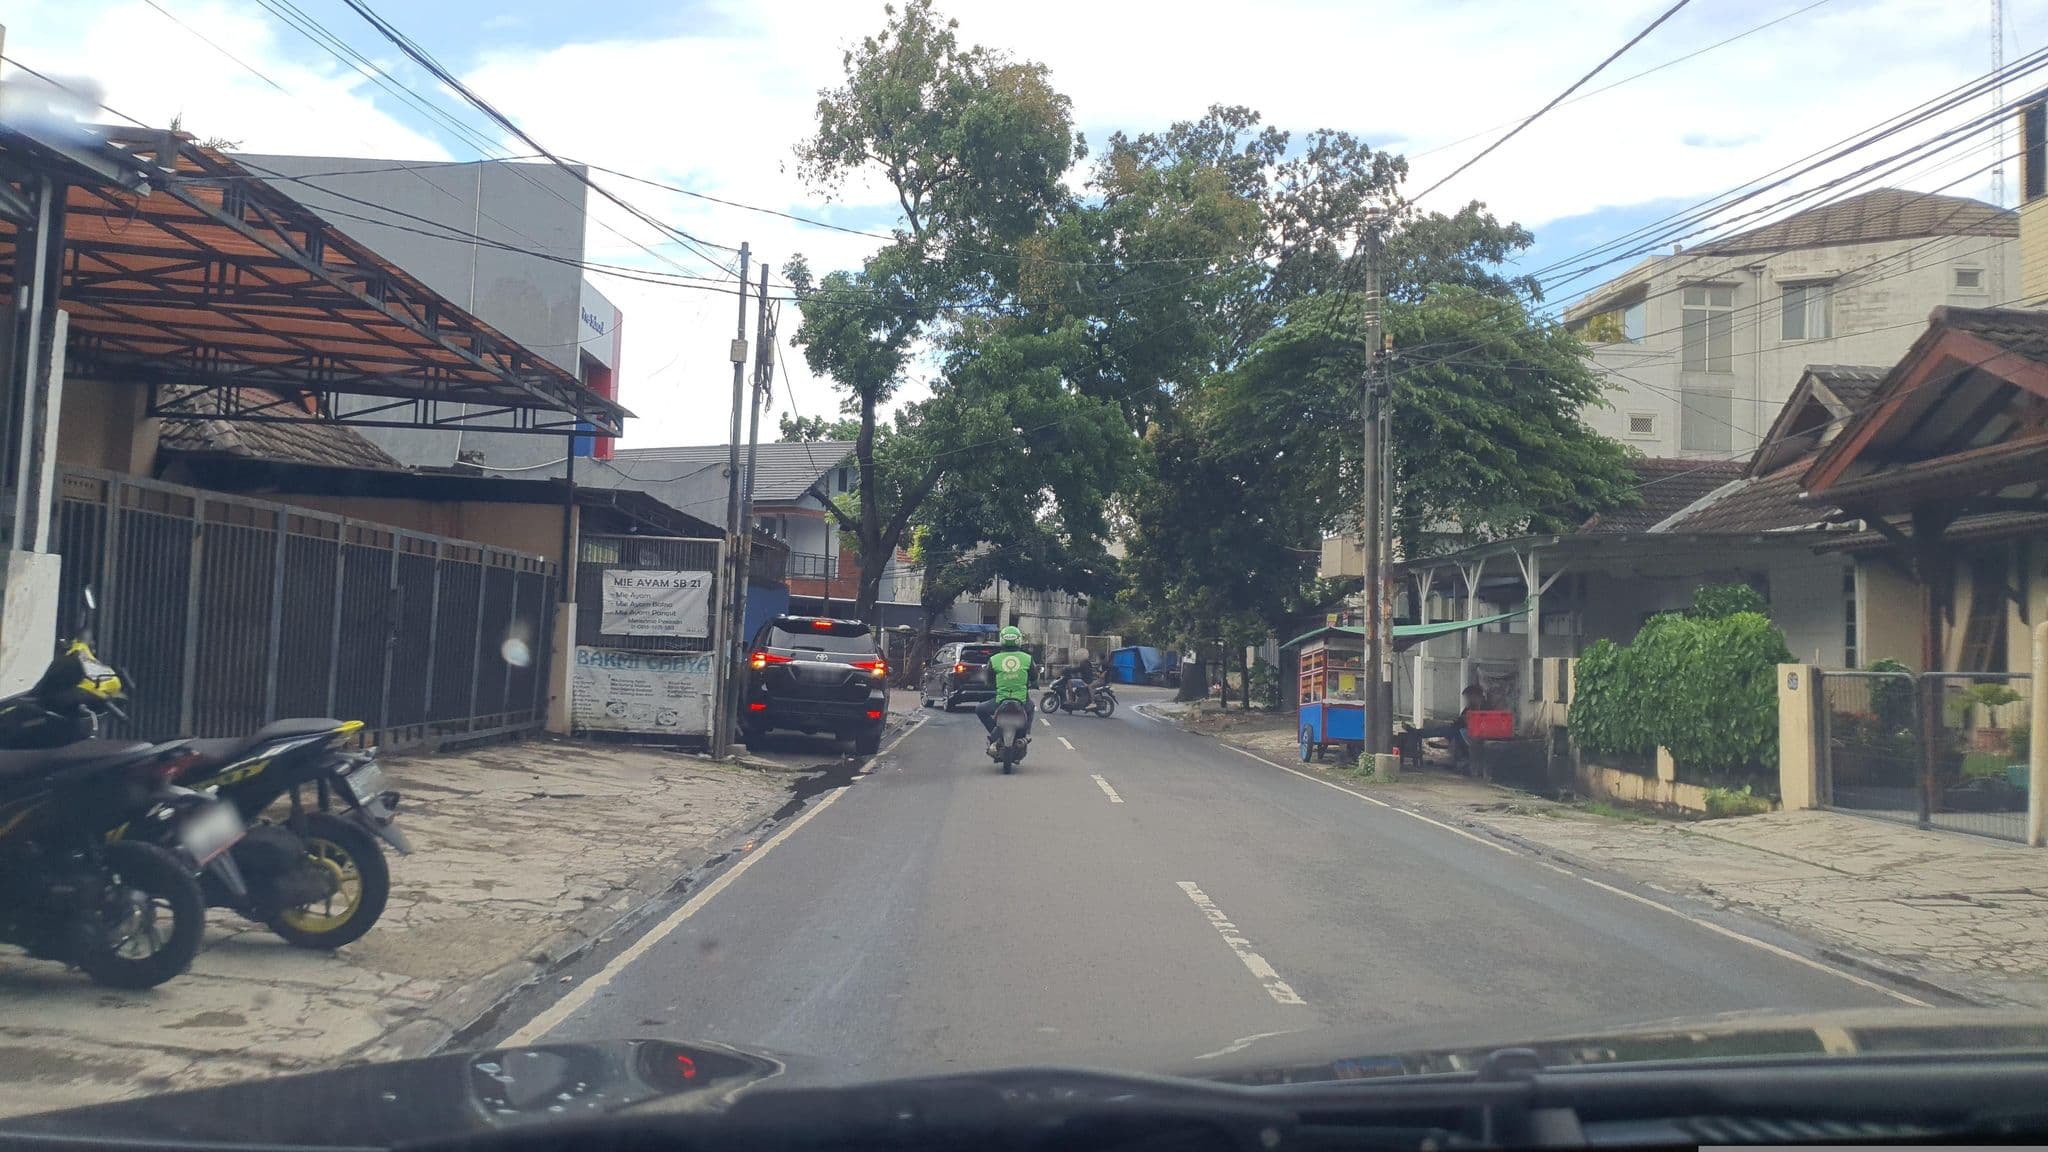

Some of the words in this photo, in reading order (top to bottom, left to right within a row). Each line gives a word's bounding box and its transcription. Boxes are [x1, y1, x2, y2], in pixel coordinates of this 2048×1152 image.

[614, 578, 633, 587] MIE
[636, 579, 669, 588] AYAM
[673, 579, 687, 588] SB
[690, 579, 701, 588] 21
[630, 592, 651, 600] Ayam
[576, 649, 640, 669] BAKMI
